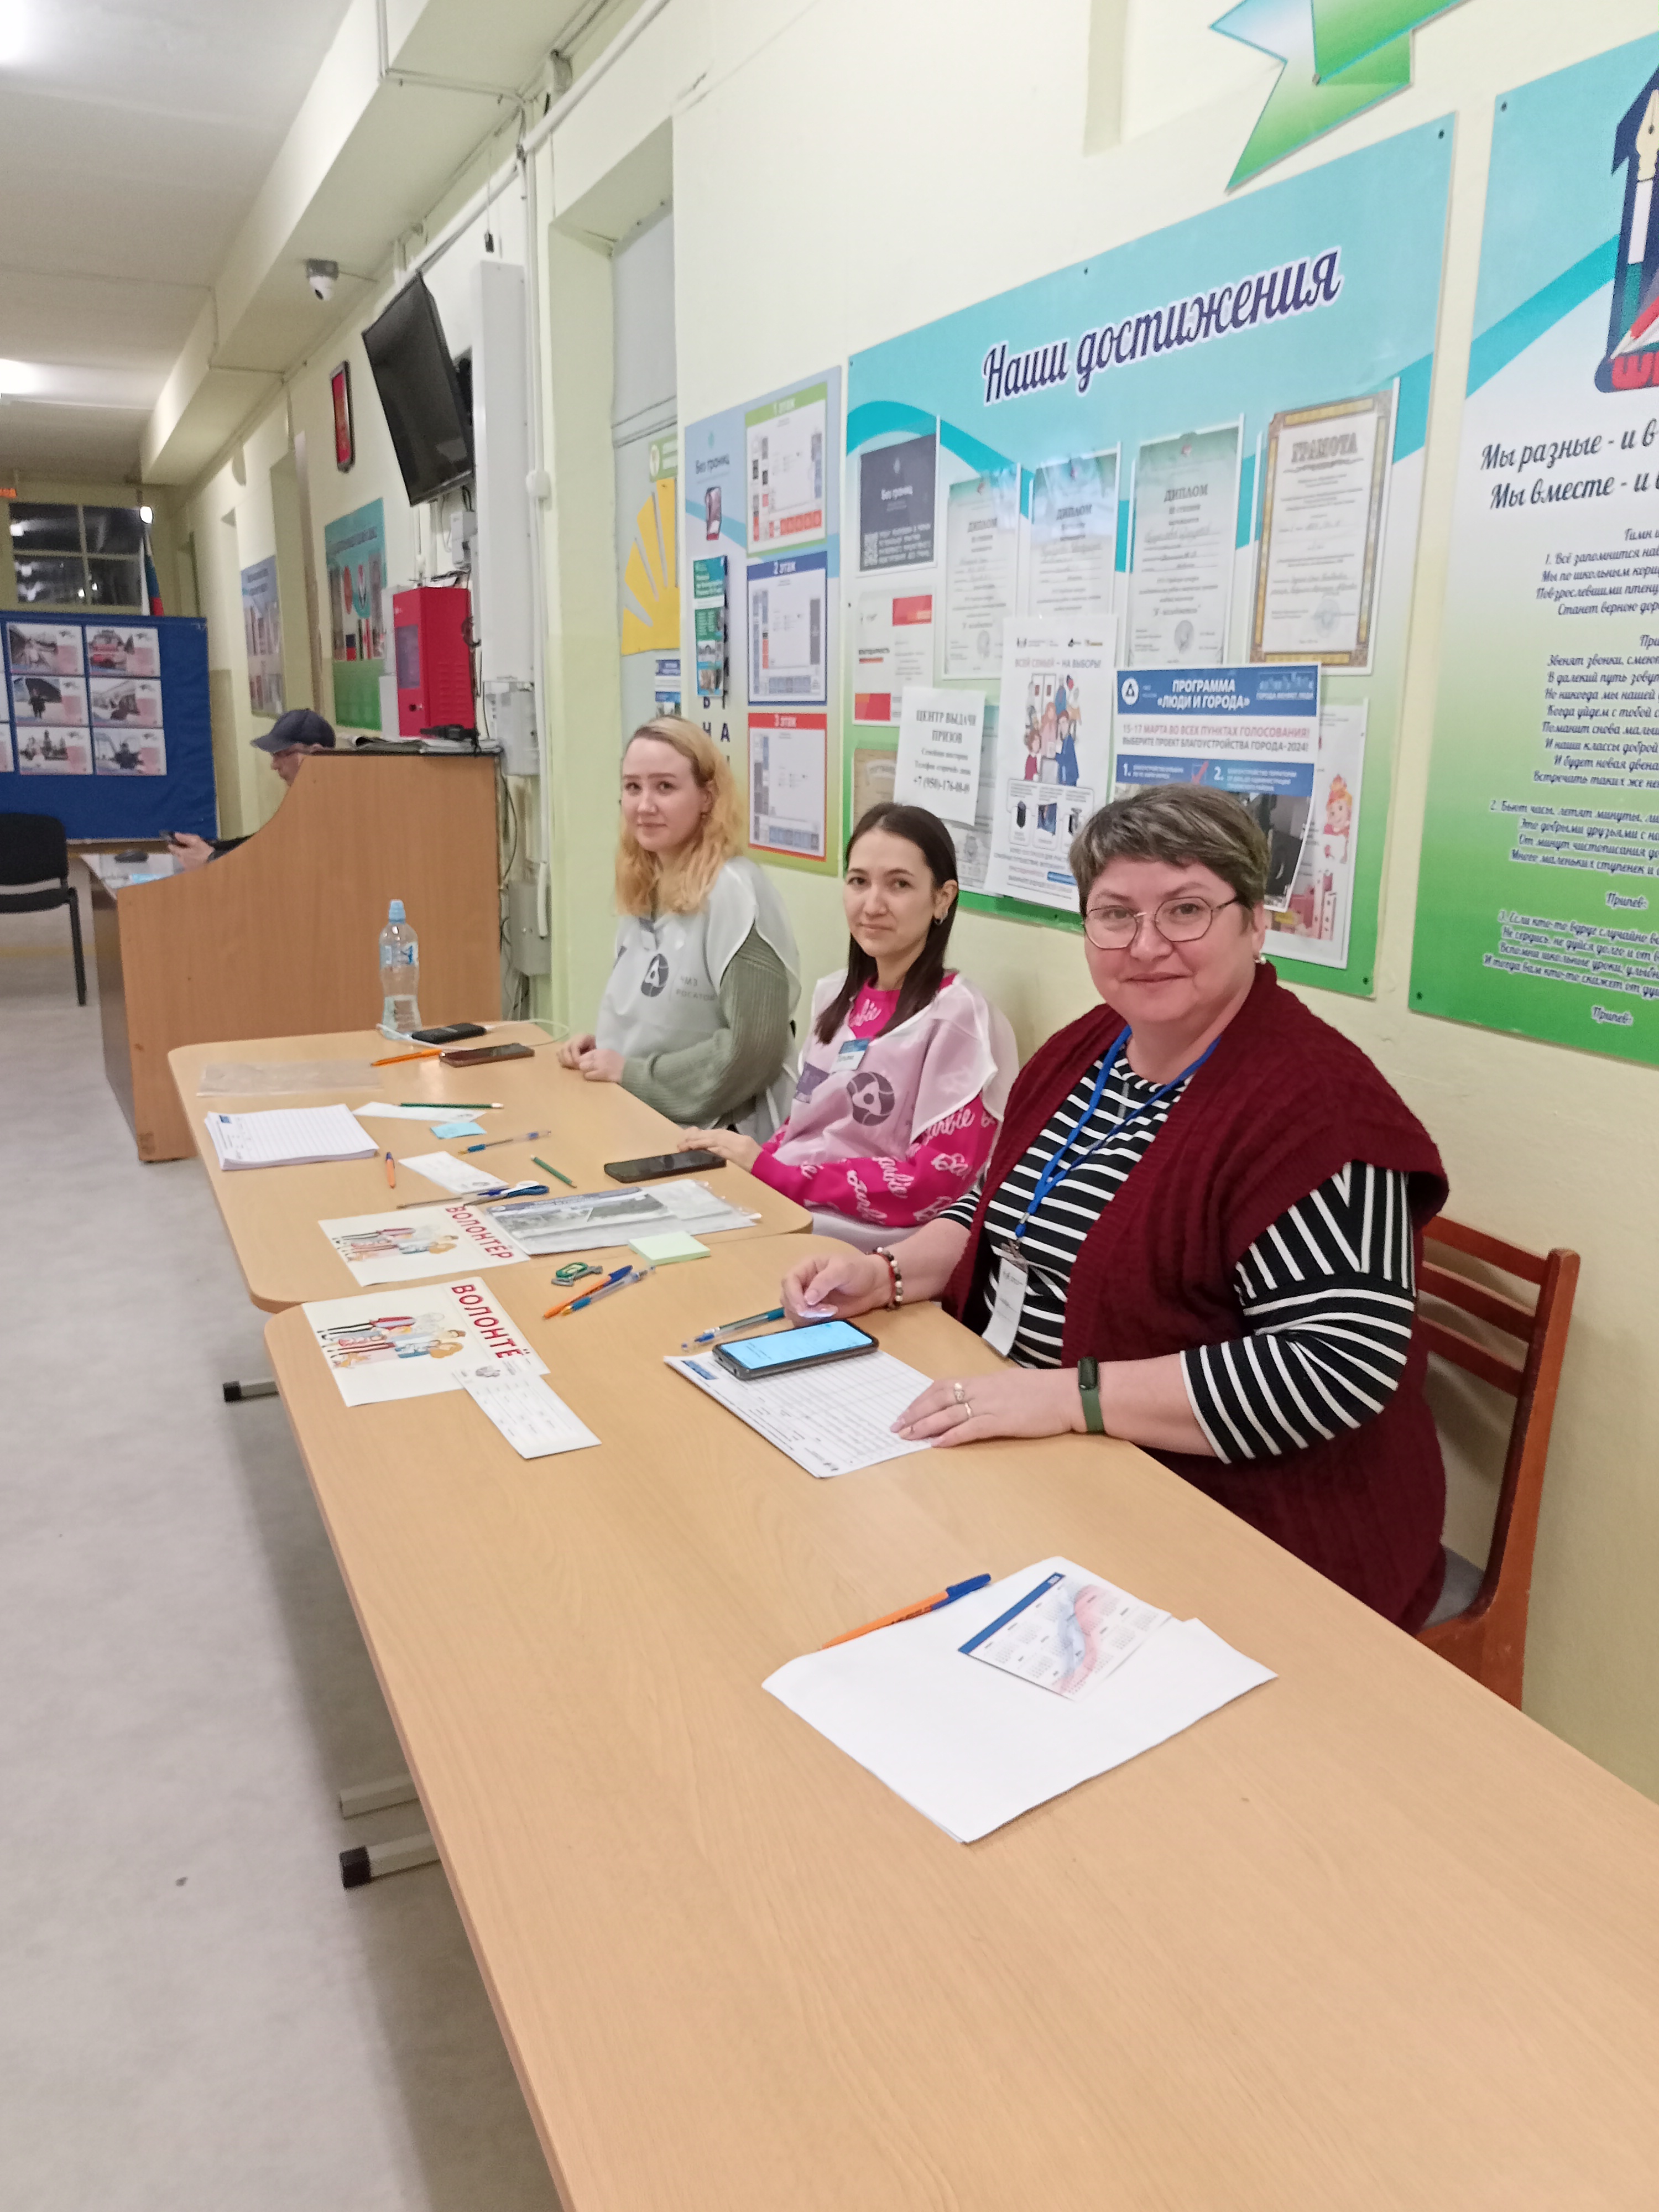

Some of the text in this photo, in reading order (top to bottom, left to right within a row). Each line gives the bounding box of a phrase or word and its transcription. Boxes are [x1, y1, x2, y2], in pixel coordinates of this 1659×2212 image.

[983, 250, 1342, 403] Наши достижения
[1480, 443, 1516, 470] Мы
[1517, 435, 1602, 473] разные
[1621, 430, 1636, 450] и
[1164, 484, 1208, 502] ДИПЛОМ
[1490, 482, 1526, 510] Мы
[1530, 478, 1615, 504] вместе
[1634, 472, 1650, 492] и
[1625, 528, 1652, 541] Гимн
[1573, 549, 1640, 566] запомнится
[1542, 570, 1558, 582] Мы
[1559, 572, 1572, 581] по
[1573, 567, 1630, 580] школьным
[1536, 585, 1623, 602] Повзрослевшими
[1557, 603, 1598, 615] Станет
[1600, 601, 1639, 616] верною
[1547, 654, 1584, 666] Звенят
[1172, 679, 1235, 693] ПРОГРАММА
[1599, 674, 1628, 686] путь
[1193, 695, 1201, 708] И
[1558, 691, 1599, 703] никогда
[1601, 691, 1619, 700] мы
[1620, 688, 1656, 700] нашей
[916, 709, 945, 723] ЦЕНТР
[1547, 705, 1575, 720] Когда
[1618, 705, 1652, 718] тобой
[1144, 724, 1167, 734] МАРТА
[1181, 725, 1199, 735] ВСЕХ
[1201, 726, 1238, 737] ПУНКТАХ
[1239, 726, 1310, 738] ГОЛОСОВАНИЯ!
[1542, 721, 1590, 734] Поманит
[1592, 722, 1621, 735] снова
[932, 729, 963, 744] ПРИЗОВ
[1122, 737, 1154, 746] ВЫБЕРИТЕ
[1155, 738, 1180, 747] ПРОЕКТ
[1181, 738, 1249, 750] БЛАГОУСТРОЙСТВА
[1554, 741, 1582, 750] наши
[1583, 742, 1621, 753] классы
[1623, 740, 1658, 756] доброй
[1563, 755, 1594, 771] будет
[1595, 757, 1627, 770] новая
[1532, 770, 1588, 784] Встречать
[1589, 775, 1625, 787] таких
[1627, 778, 1645, 788] же
[1501, 800, 1528, 812] Бьют
[1558, 808, 1593, 818] летят
[1540, 821, 1584, 833] добрыми
[1585, 826, 1638, 839] друзьями
[1537, 839, 1570, 851] минут
[1572, 843, 1646, 858] чистописания
[1541, 855, 1594, 869] маленьких
[445, 1206, 514, 1259] ВОЛОНТЁР
[451, 1284, 531, 1359] ВОЛОНТЁ
